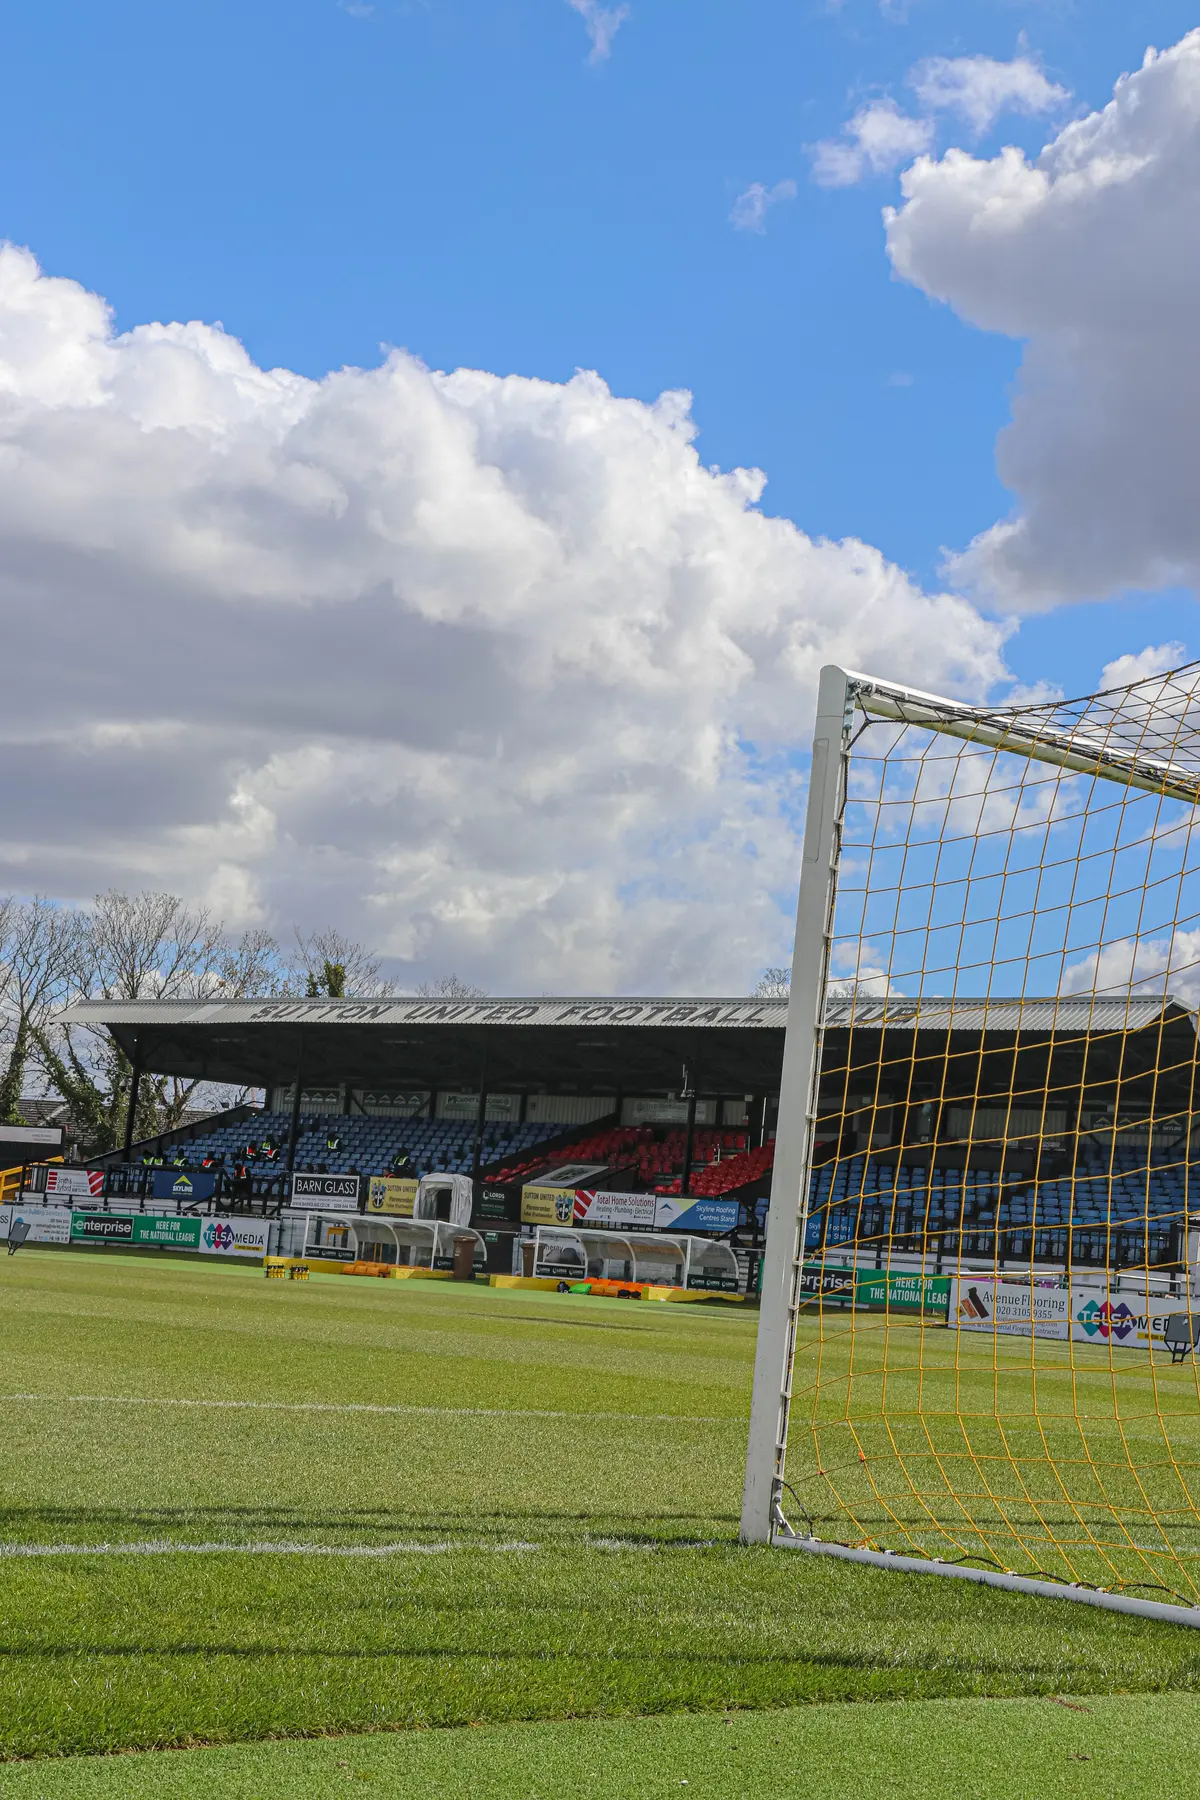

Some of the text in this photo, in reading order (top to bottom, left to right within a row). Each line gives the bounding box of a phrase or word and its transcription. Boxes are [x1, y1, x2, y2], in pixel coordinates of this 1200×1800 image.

[250, 1004, 392, 1021] SUTTON
[403, 1005, 540, 1021] UNITED
[555, 1005, 766, 1023] FOOTBALL
[297, 1180, 354, 1194] BARN GLASS
[597, 1195, 654, 1208] Total Home Solutions
[596, 1206, 612, 1214] Heating
[614, 1208, 632, 1216] Plumbing
[634, 1209, 653, 1217] Electrical
[696, 1205, 736, 1215] Skyline Roofing
[720, 1215, 735, 1223] Stand
[75, 1220, 132, 1234] enterprise
[156, 1221, 181, 1232] HERE FOR
[140, 1230, 195, 1242] THE NATIONAL LEAGUE
[205, 1230, 264, 1245] TELSA MEDIA
[800, 1273, 854, 1290] erprise
[896, 1277, 934, 1291] HERE FOR
[870, 1288, 885, 1300] THE
[927, 1292, 948, 1305] LEAG
[982, 1291, 1021, 1306] Avenue
[996, 1305, 1053, 1320] 020 3105 9355
[1081, 1310, 1135, 1329] TELSA
